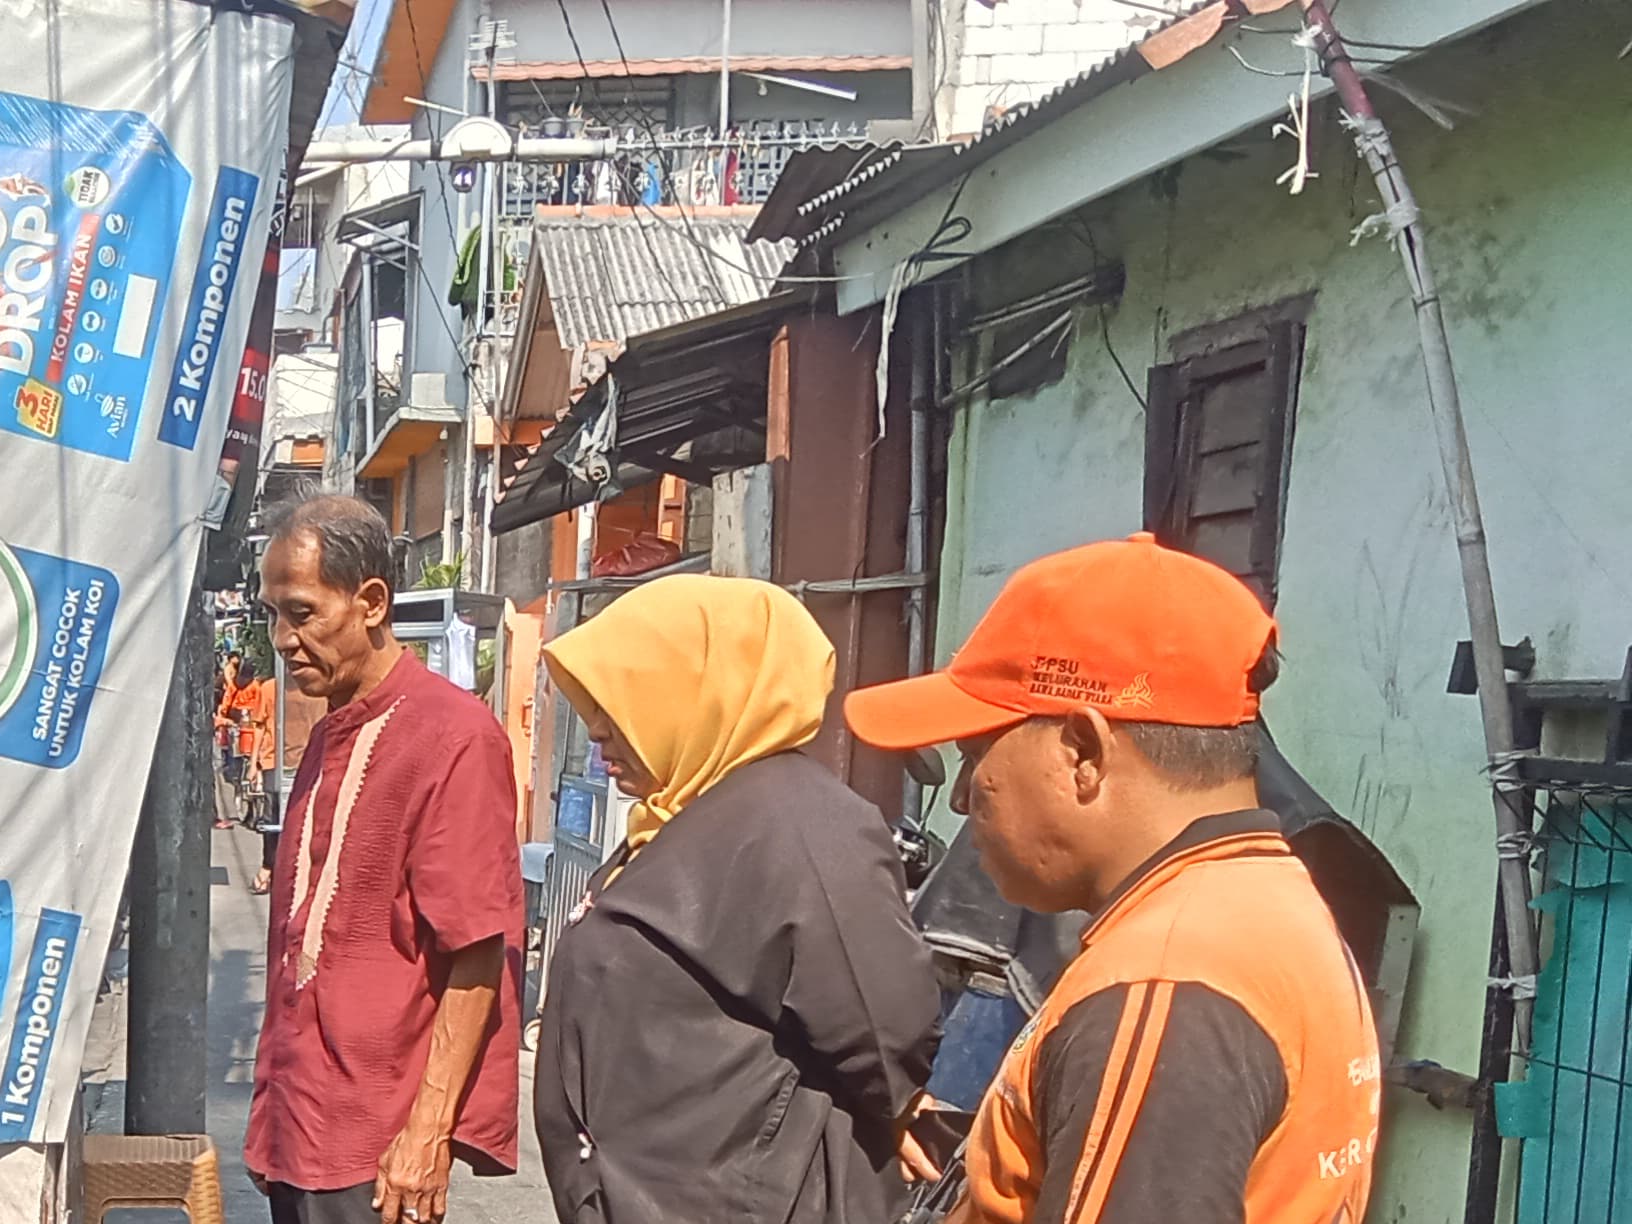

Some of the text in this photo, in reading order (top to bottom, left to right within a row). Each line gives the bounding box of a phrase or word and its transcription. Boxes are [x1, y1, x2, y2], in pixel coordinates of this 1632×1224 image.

[50, 290, 80, 363] KOLAM
[68, 233, 92, 287] IKAN
[172, 196, 246, 422] 2 Komponen
[35, 390, 54, 431] HARI
[32, 587, 82, 742] SANGAT COCOK
[48, 578, 106, 758] UNTUK KOLAM KOI
[0, 937, 67, 1126] 1 Komponen
